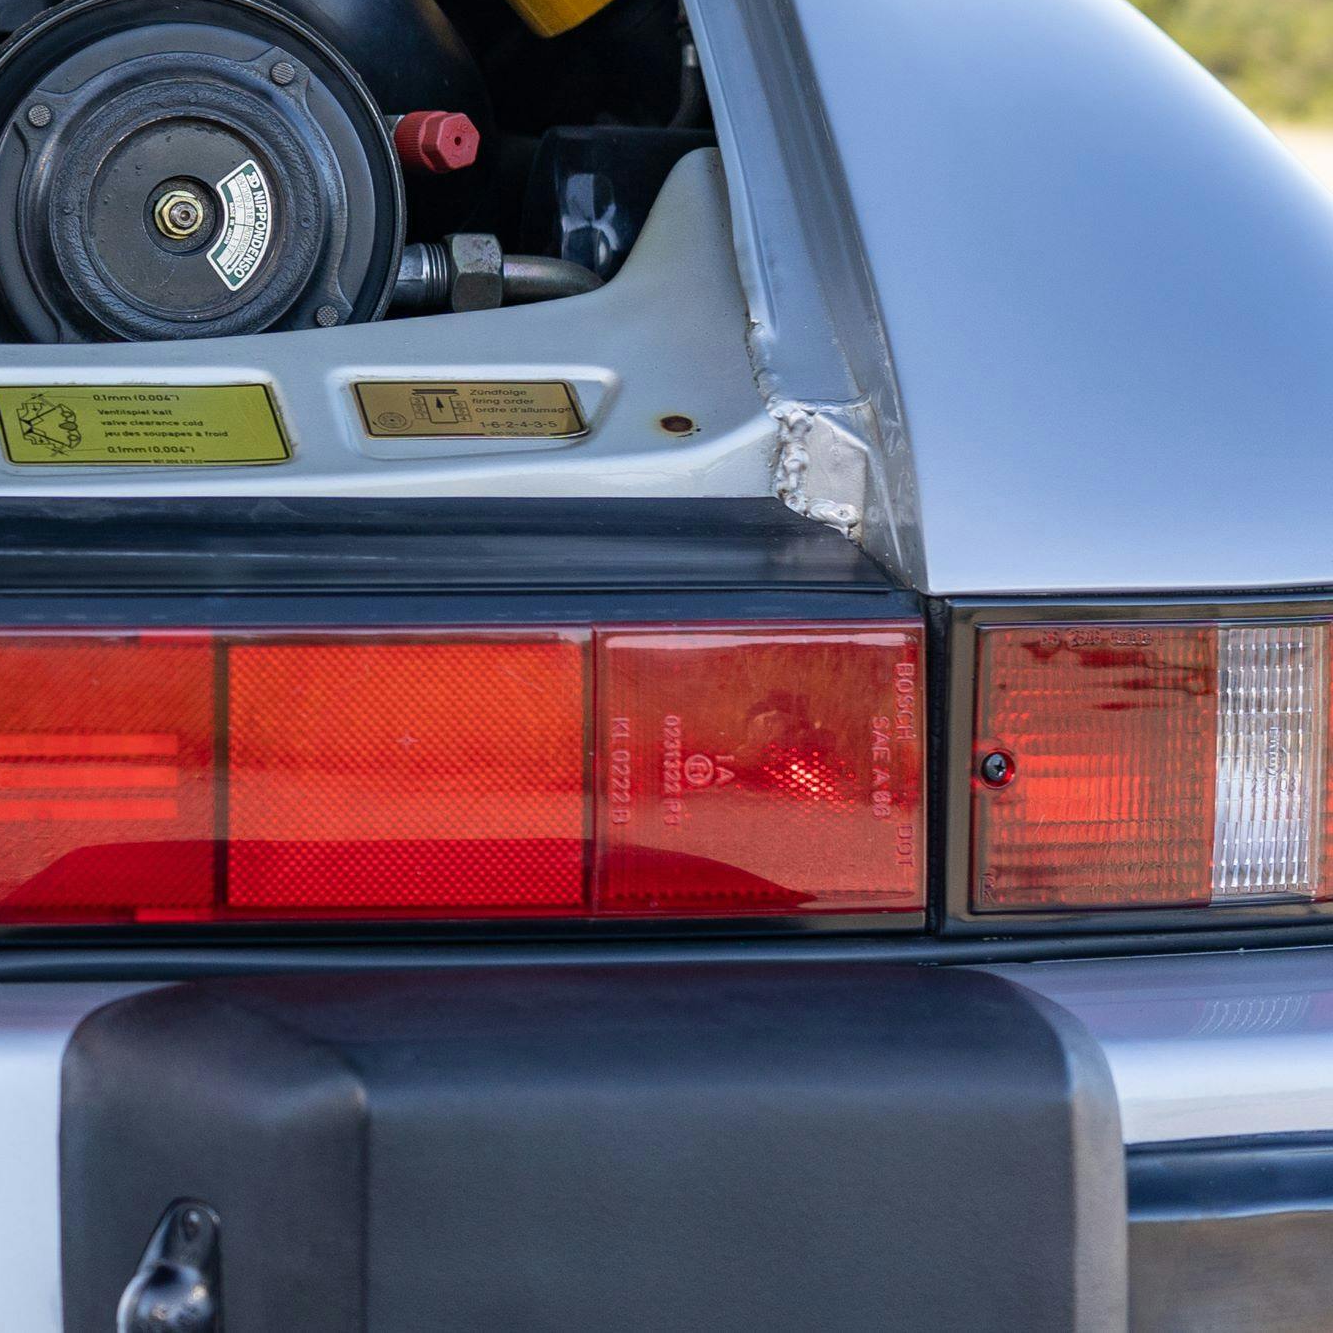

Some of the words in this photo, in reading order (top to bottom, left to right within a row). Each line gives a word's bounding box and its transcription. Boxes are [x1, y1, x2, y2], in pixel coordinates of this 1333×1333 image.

[234, 190, 268, 280] NIPPONDENSO
[469, 389, 527, 397] Zündfolge
[97, 409, 150, 417] Ventilspiel
[129, 419, 180, 427] clearance
[479, 420, 558, 429] 1-6-2-4-3-5
[104, 430, 121, 438] jeu
[142, 430, 193, 439] soupapes
[895, 662, 917, 742] BOSCH
[871, 716, 891, 763] SAE
[871, 768, 891, 786] A
[895, 823, 914, 868] DOT
